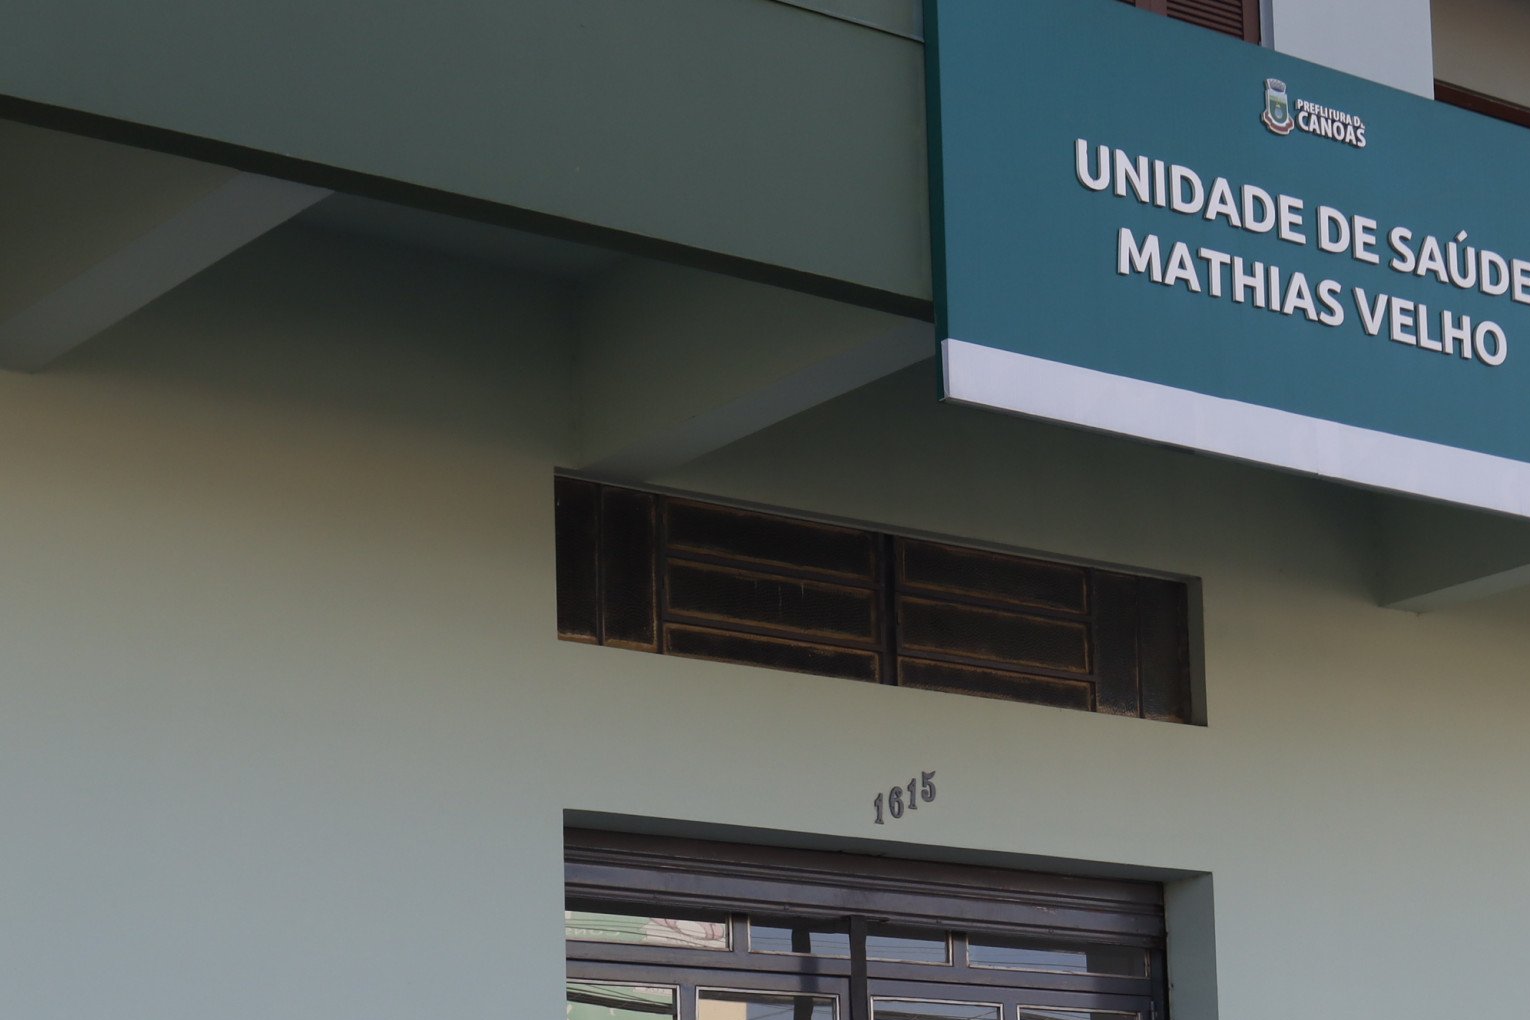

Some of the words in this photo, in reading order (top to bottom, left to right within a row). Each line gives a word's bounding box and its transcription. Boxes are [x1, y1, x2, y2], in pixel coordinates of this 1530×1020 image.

[1297, 110, 1367, 148] CANOAS
[1073, 138, 1307, 246] UNIDADE
[1317, 205, 1380, 265] DE
[1116, 227, 1345, 327] MATHIAS
[1353, 286, 1508, 368] VELHO
[874, 770, 937, 825] 1615
